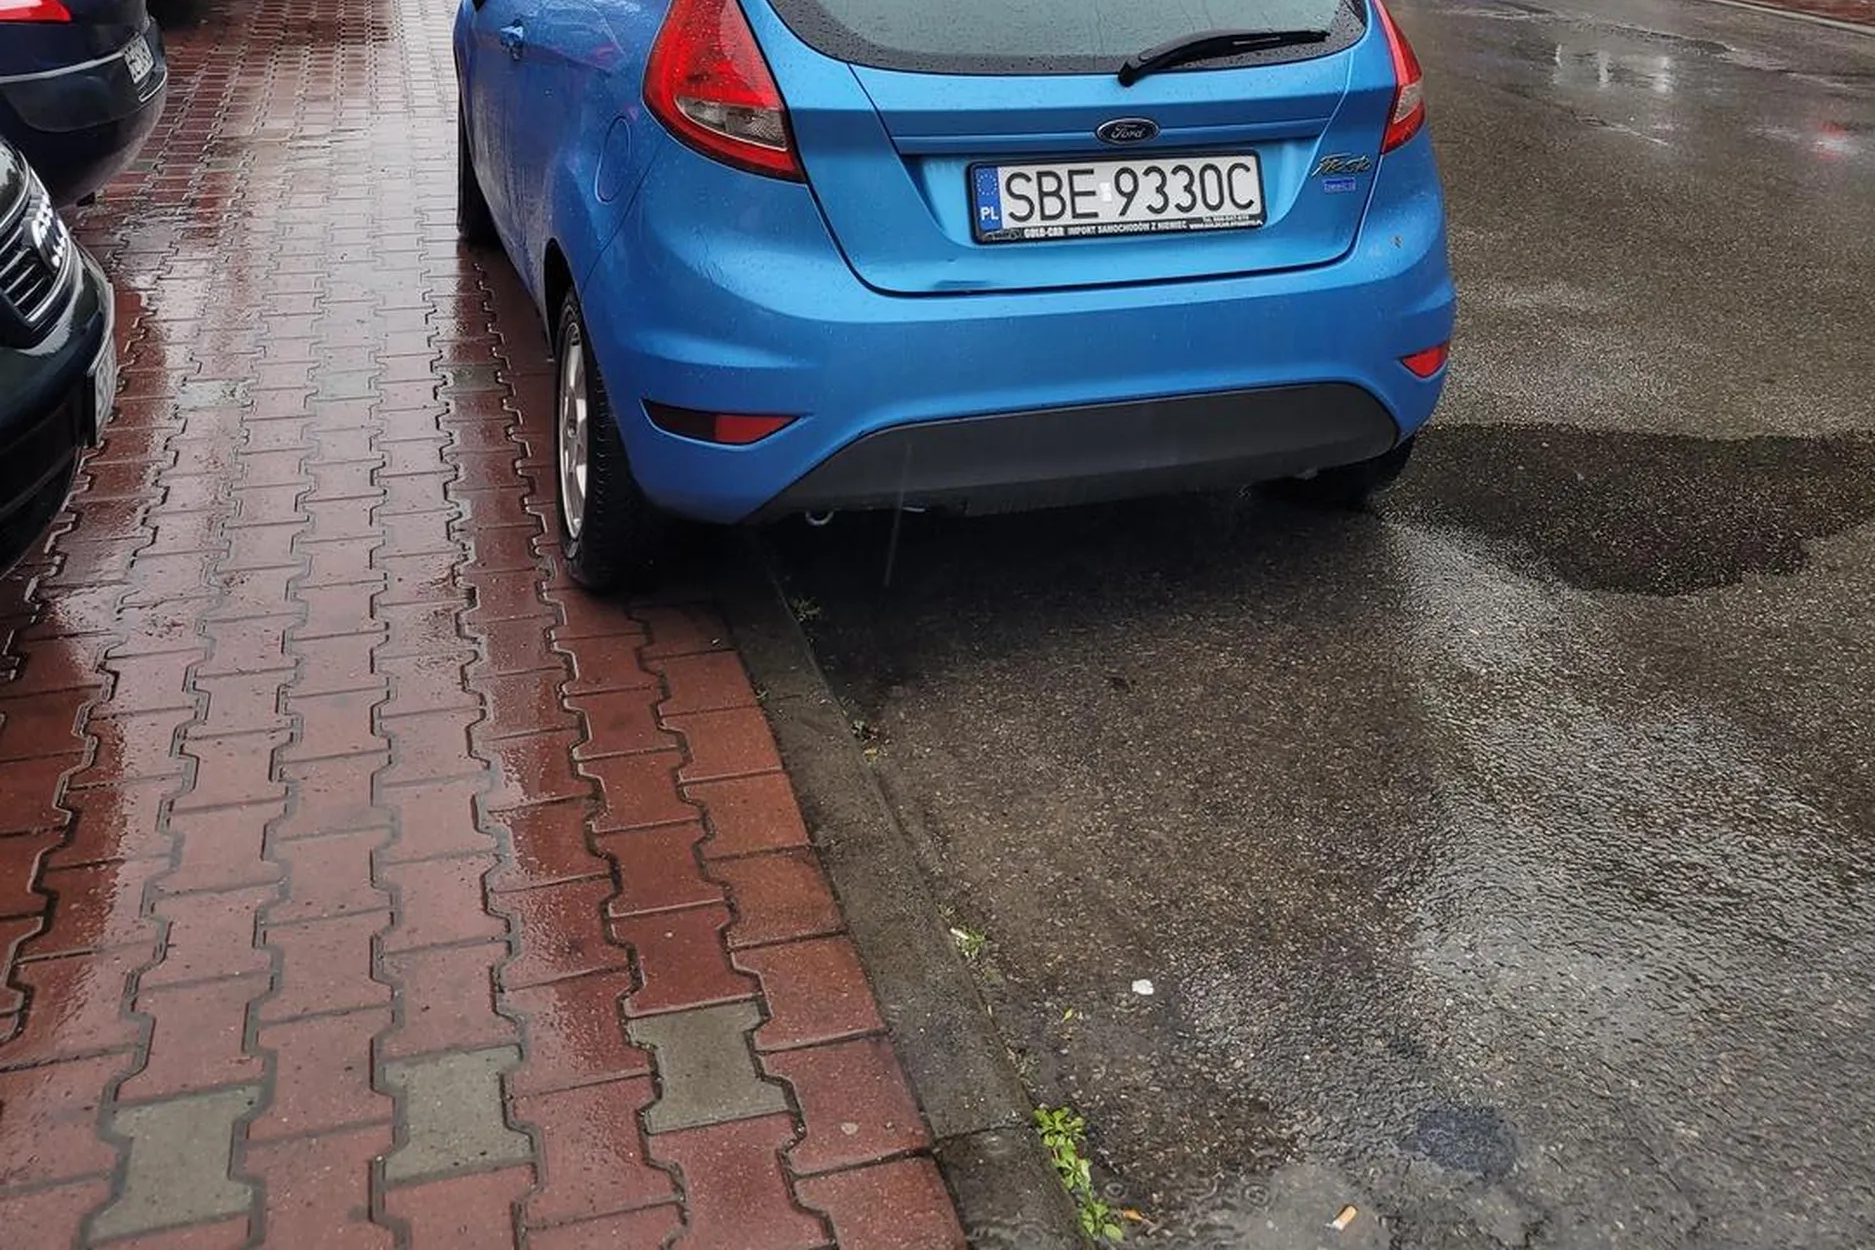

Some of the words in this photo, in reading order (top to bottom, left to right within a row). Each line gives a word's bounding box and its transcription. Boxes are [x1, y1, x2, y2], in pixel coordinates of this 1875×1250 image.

[1110, 123, 1146, 139] Ford
[1004, 168, 1100, 224] SBE
[1114, 162, 1256, 218] 9330C
[980, 206, 999, 221] PL
[1067, 224, 1097, 236] IMPORT
[1097, 220, 1149, 234] SAMOCHODÓW
[1150, 221, 1158, 231] Z
[1158, 219, 1188, 230] NIEMIEC
